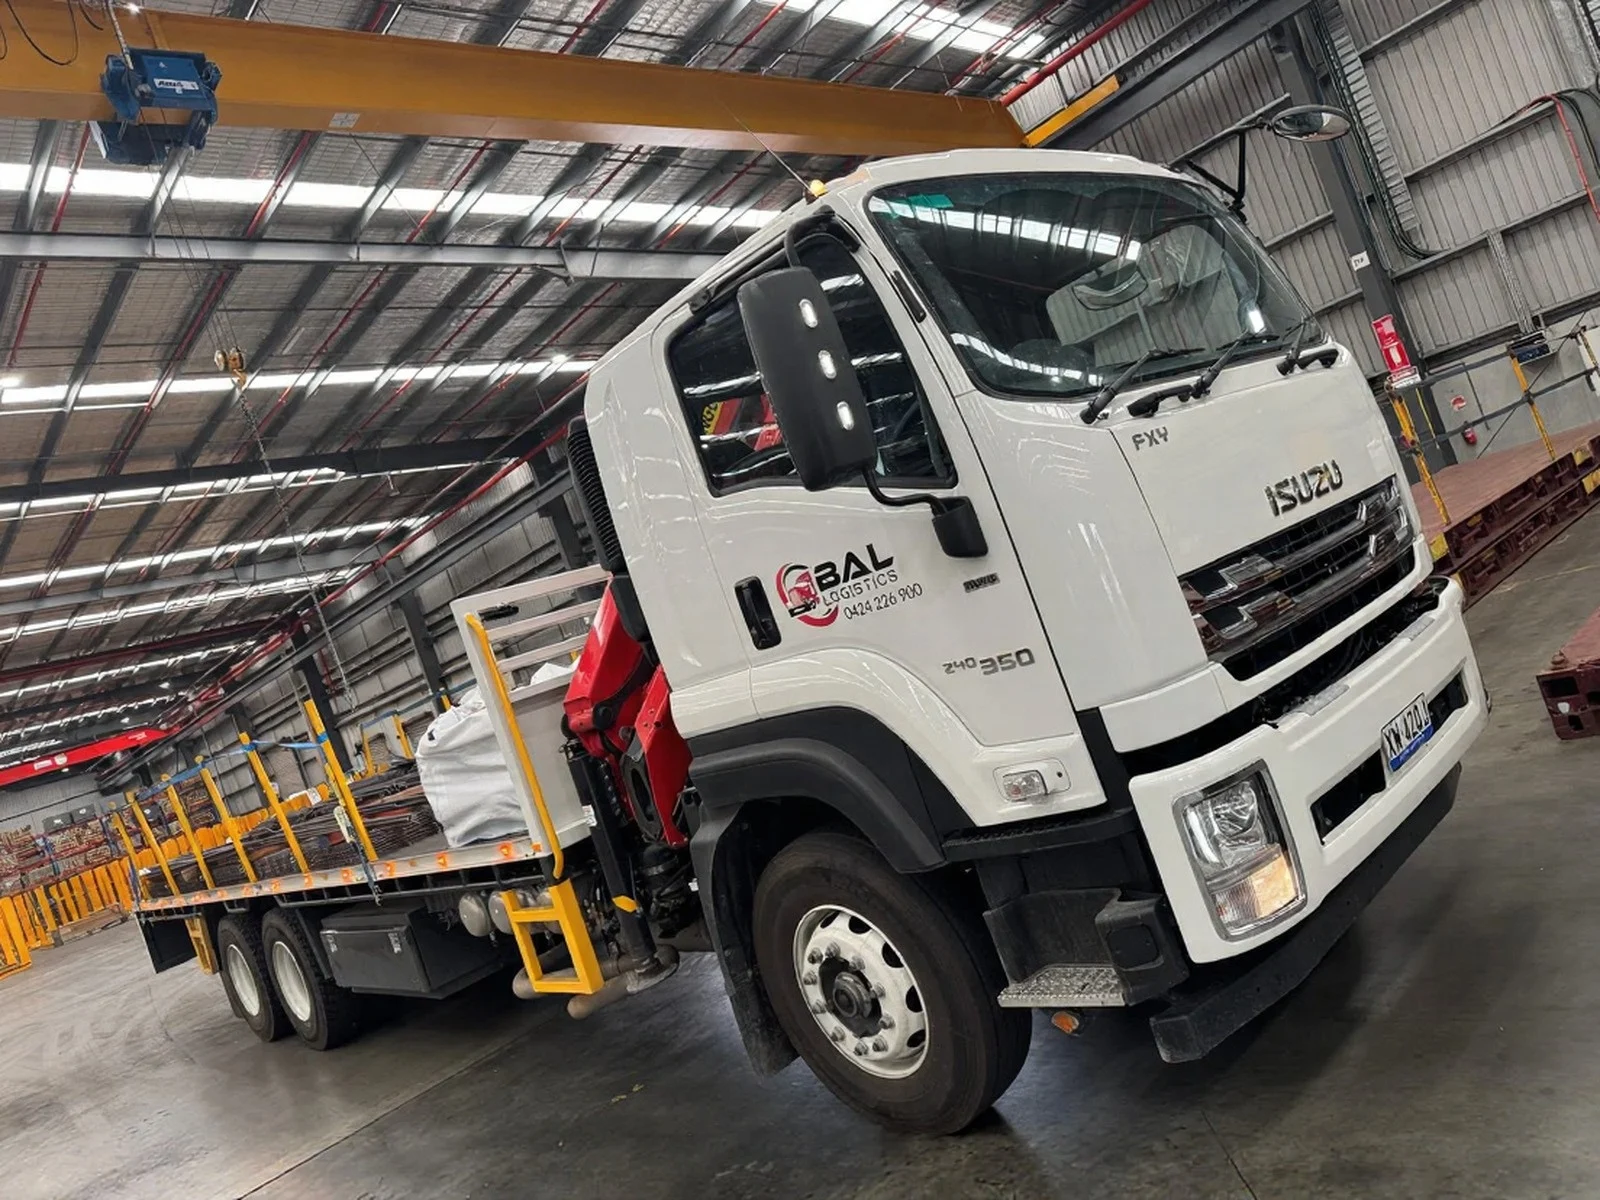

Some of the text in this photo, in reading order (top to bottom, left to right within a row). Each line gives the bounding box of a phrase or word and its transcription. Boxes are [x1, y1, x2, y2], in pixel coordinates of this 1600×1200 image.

[1131, 426, 1169, 451] FXY
[1263, 459, 1343, 517] ISUZU
[814, 543, 894, 592] BAL
[822, 569, 898, 606] LOGISTICS
[843, 583, 923, 620] 0424 226 900
[942, 648, 1036, 676] 240 350
